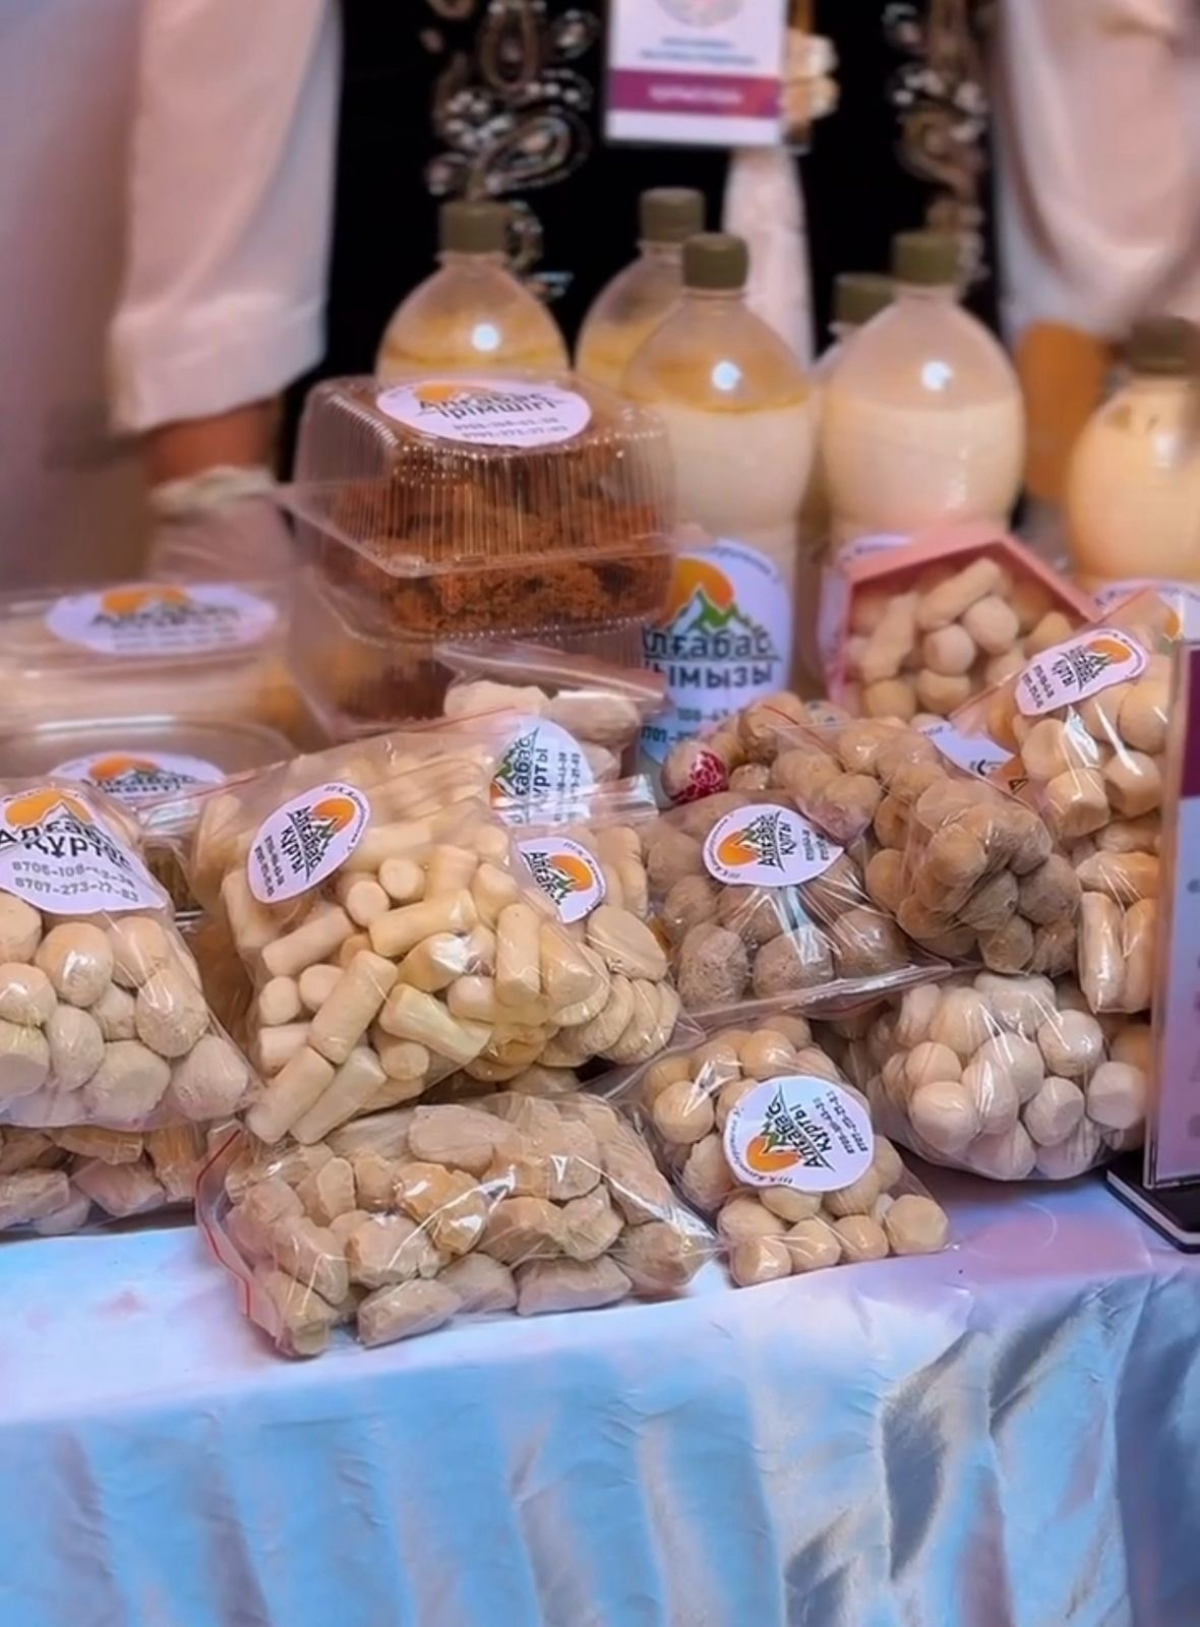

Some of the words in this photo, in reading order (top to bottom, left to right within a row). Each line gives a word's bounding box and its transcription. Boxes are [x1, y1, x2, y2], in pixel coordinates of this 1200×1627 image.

[645, 662, 772, 688] мызы
[529, 852, 561, 905] Алға
[768, 1101, 824, 1168] Алғабас
